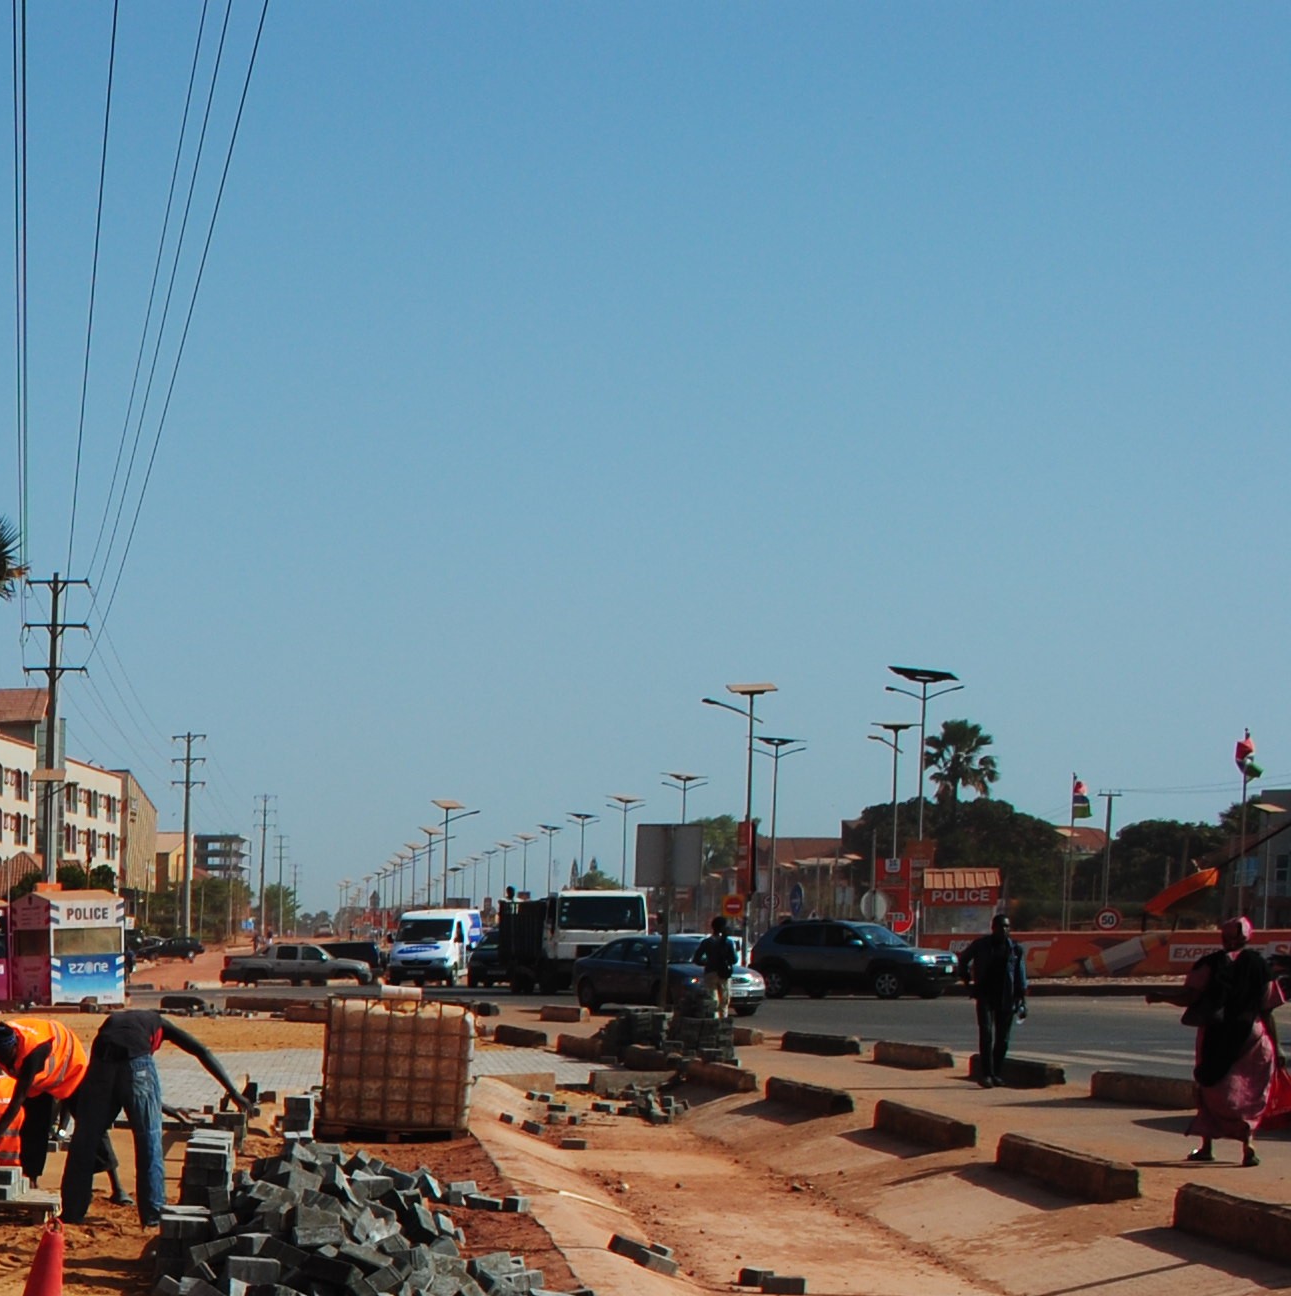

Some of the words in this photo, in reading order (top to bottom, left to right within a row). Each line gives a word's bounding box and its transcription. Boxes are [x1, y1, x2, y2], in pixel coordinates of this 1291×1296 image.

[931, 889, 990, 902] POLICE
[66, 907, 109, 920] POLICE
[1101, 914, 1114, 925] 50
